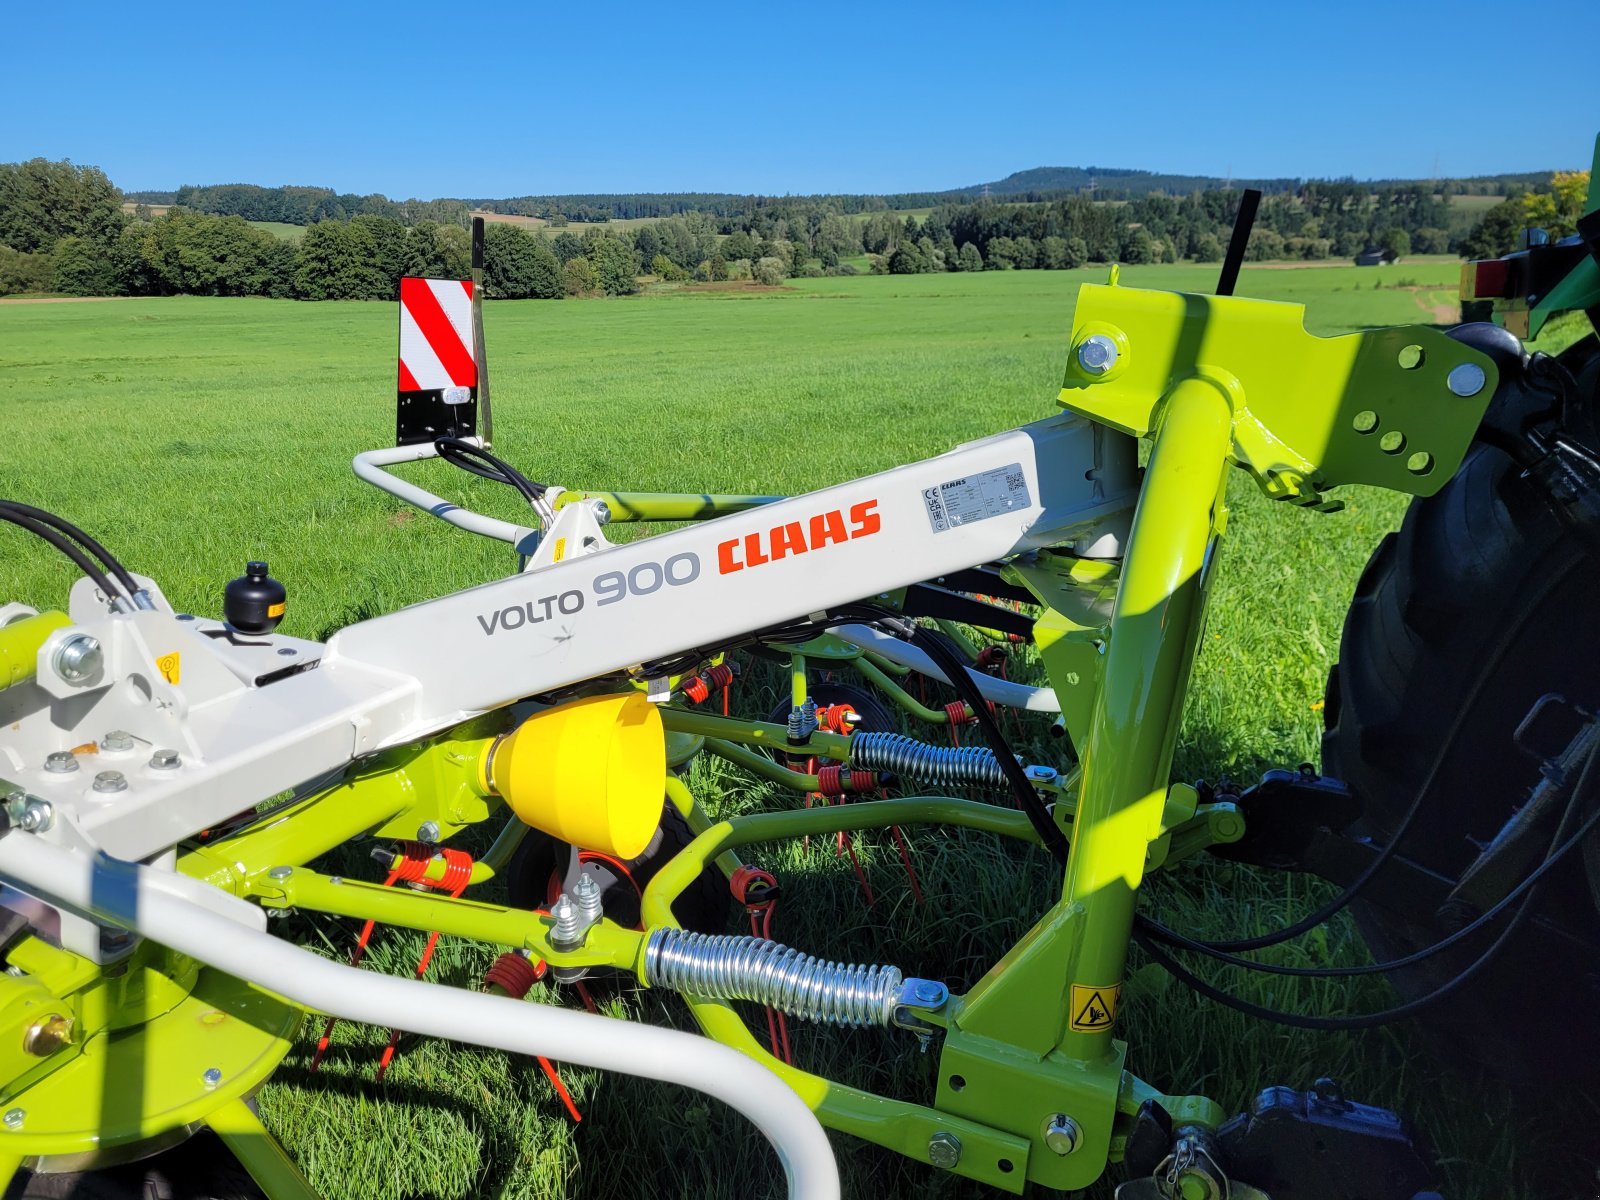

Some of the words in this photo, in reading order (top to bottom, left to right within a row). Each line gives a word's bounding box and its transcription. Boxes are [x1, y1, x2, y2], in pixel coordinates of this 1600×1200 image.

[942, 479, 966, 490] CLAAS
[925, 488, 939, 499] CE
[477, 589, 585, 636] VOLTO
[593, 552, 700, 607] 900
[718, 498, 881, 575] CLAAS
